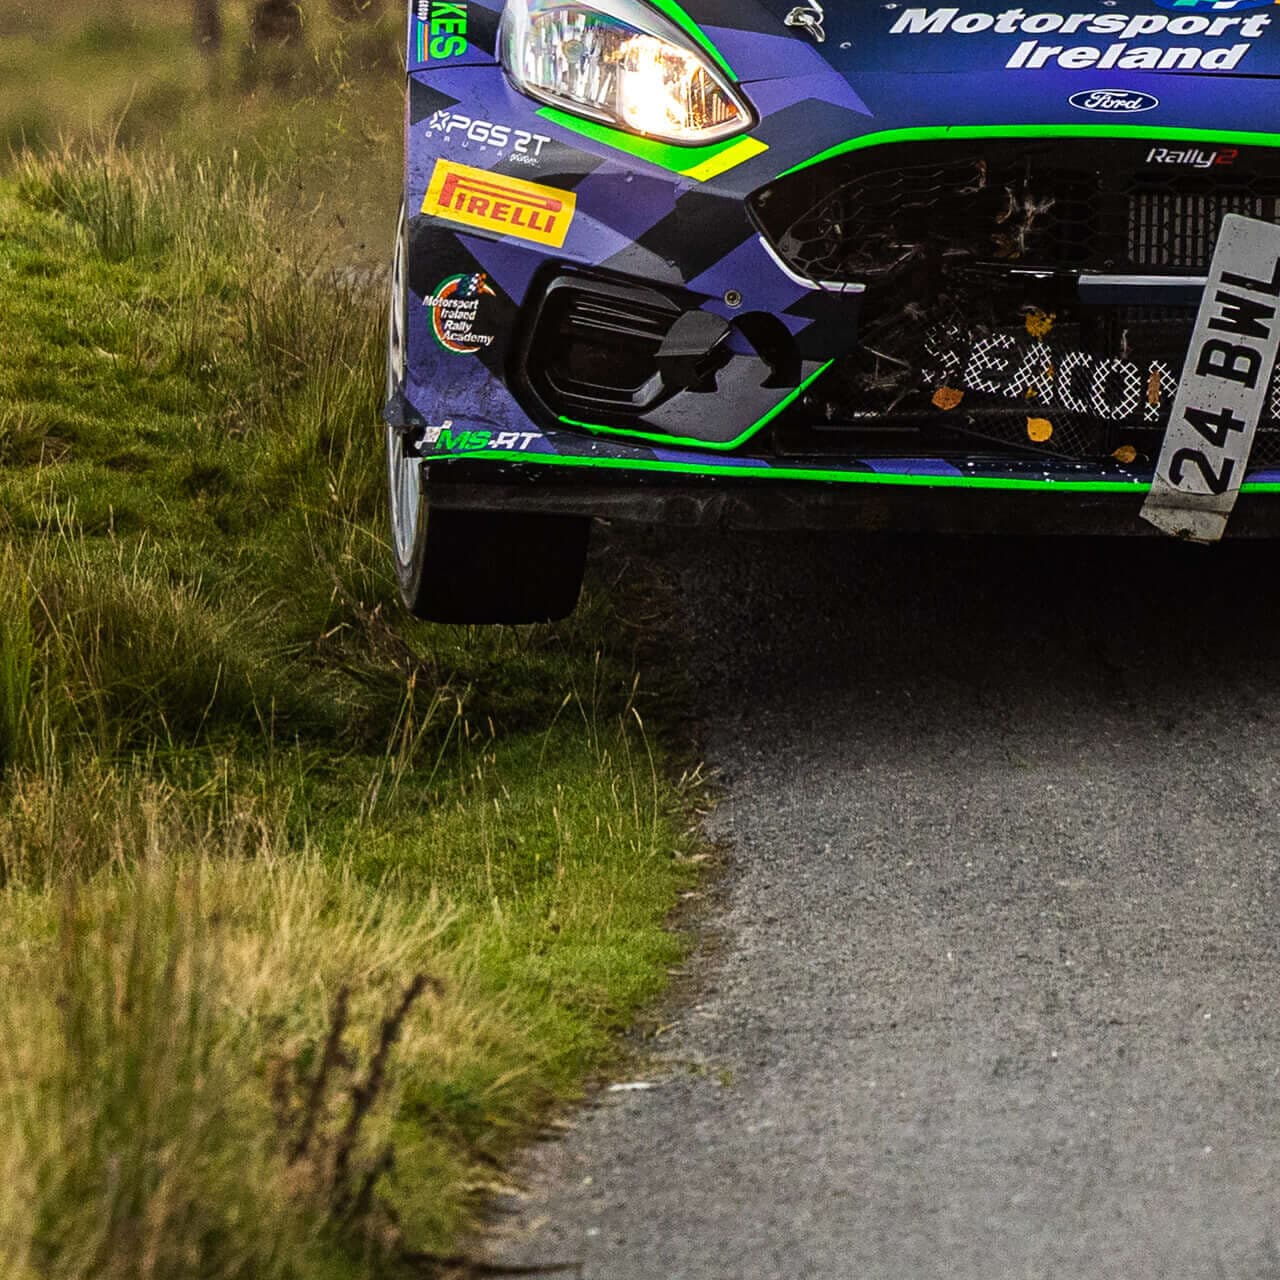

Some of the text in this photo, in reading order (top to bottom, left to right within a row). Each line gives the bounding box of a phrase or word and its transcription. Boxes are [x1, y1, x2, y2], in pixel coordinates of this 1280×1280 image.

[430, 1, 468, 59] KES
[889, 7, 1272, 40] Motorsport
[1005, 39, 1251, 71] Ireland
[1084, 91, 1144, 110] Ford
[1146, 147, 1238, 168] Rally2
[438, 173, 563, 234] PIRELLI
[422, 295, 479, 310] Motorsport
[441, 308, 477, 320] Ireland
[443, 320, 473, 333] Rally
[442, 330, 495, 346] Academy
[1167, 401, 1251, 495] 24
